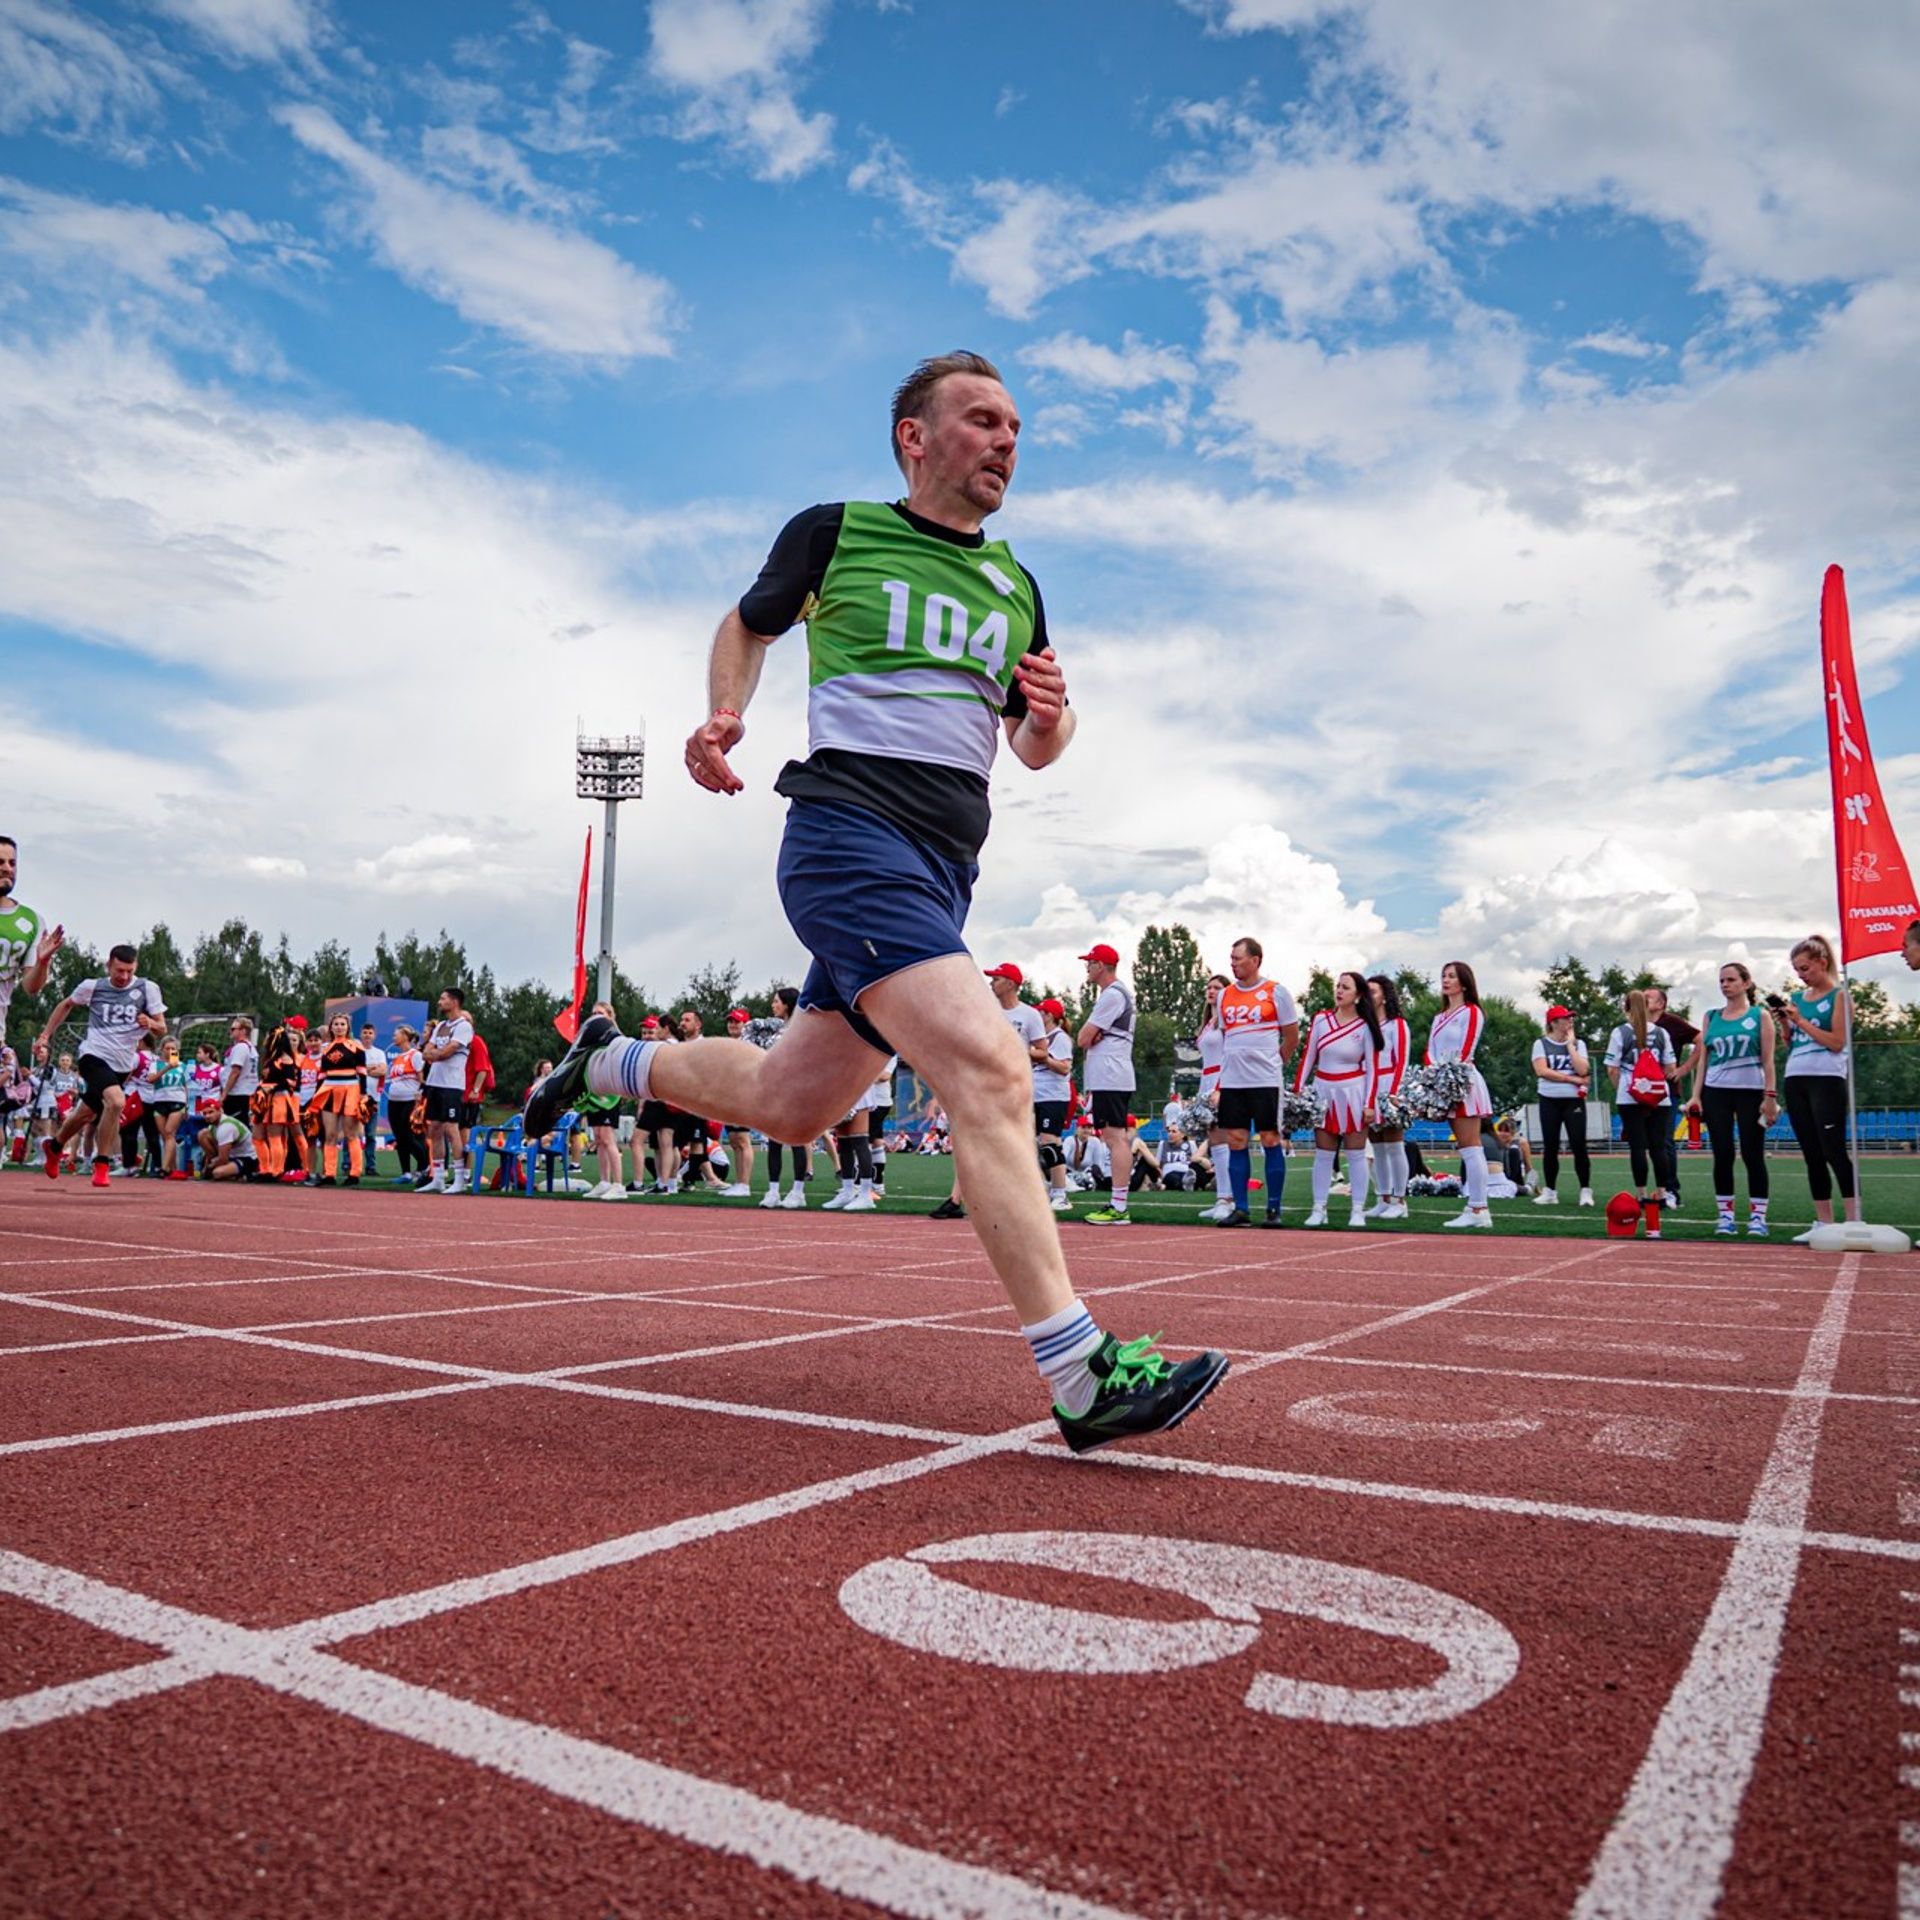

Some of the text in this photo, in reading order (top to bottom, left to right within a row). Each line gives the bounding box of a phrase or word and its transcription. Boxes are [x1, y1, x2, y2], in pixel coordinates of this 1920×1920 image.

[882, 580, 1008, 678] 104
[101, 1003, 138, 1024] 129
[1224, 1005, 1263, 1024] 324
[1712, 1034, 1751, 1058] 017
